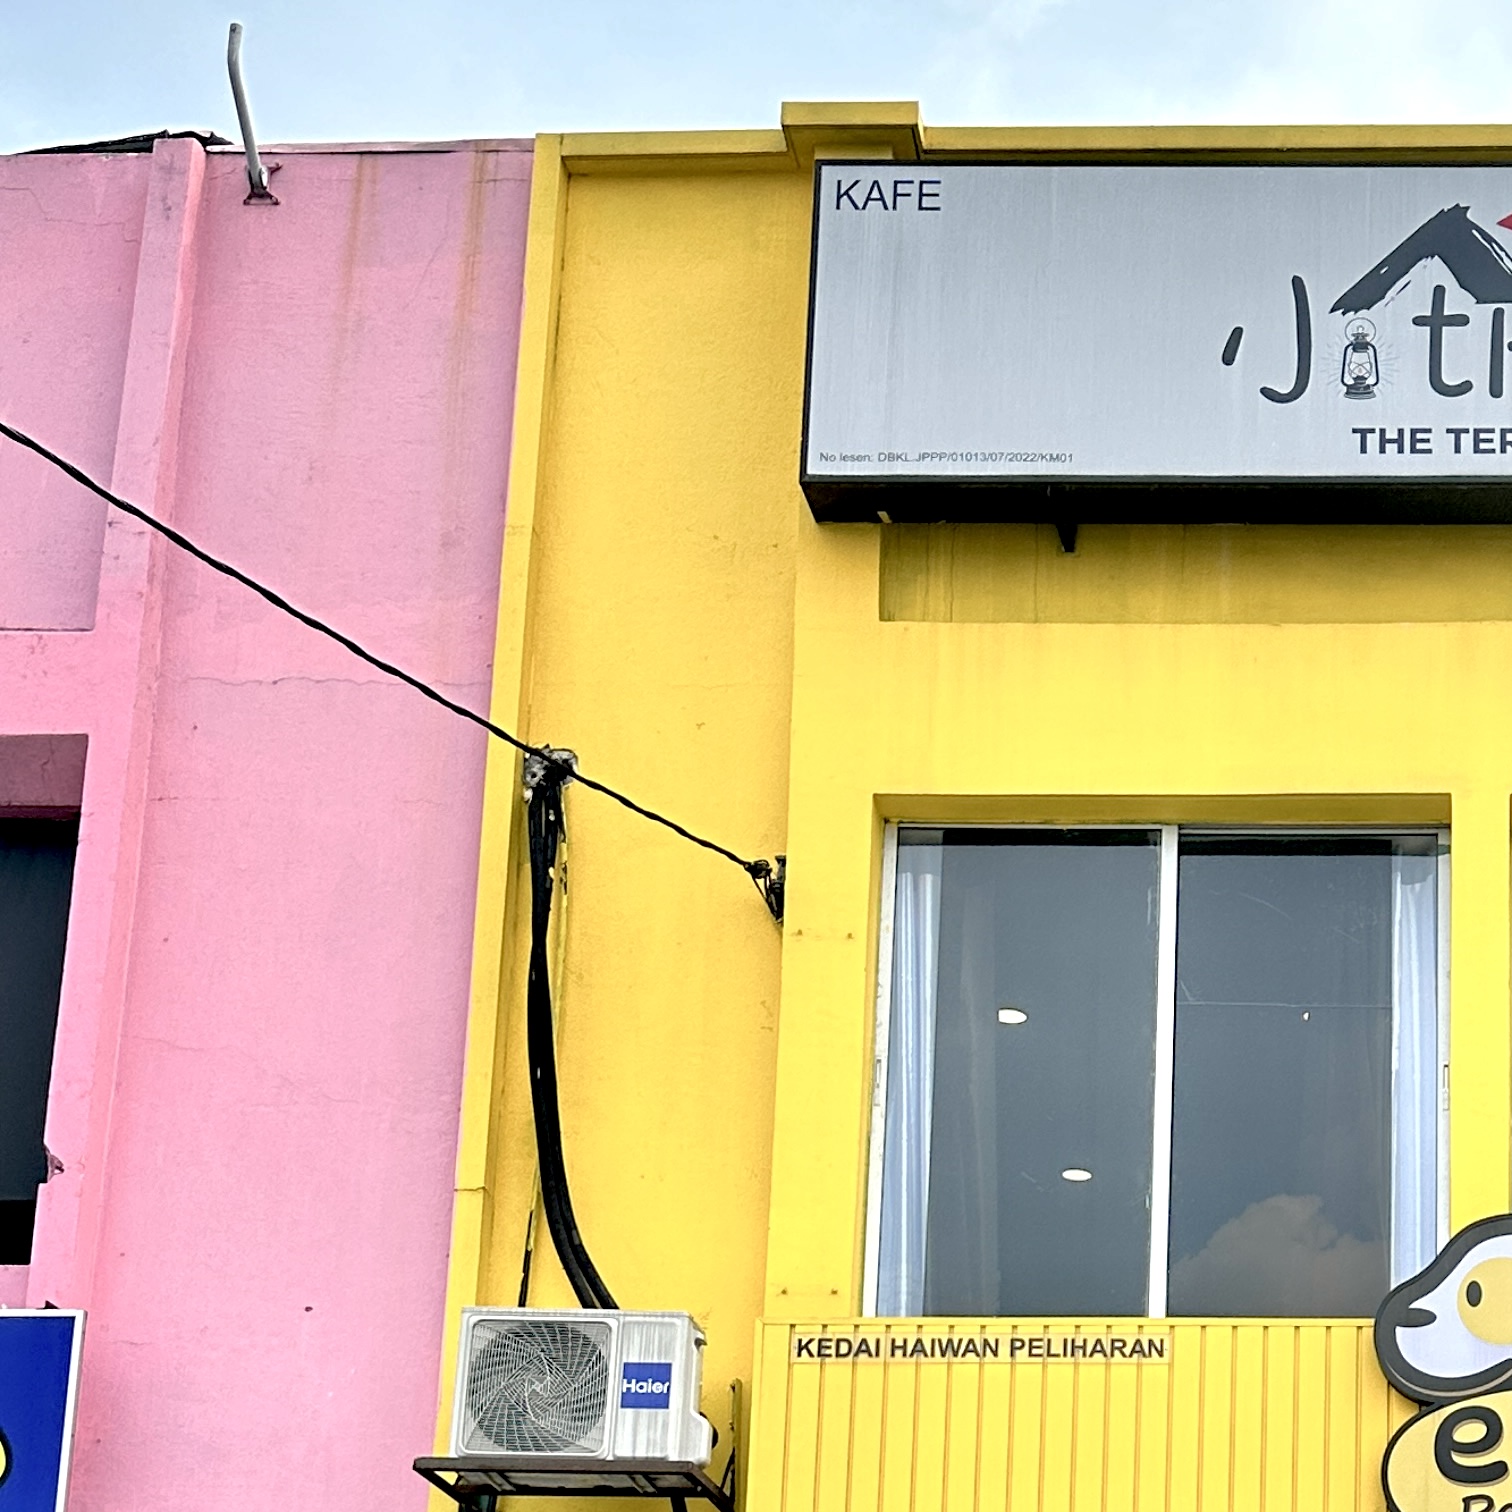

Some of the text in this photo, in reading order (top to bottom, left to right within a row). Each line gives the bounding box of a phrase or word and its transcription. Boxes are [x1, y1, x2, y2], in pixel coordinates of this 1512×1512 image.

[836, 179, 942, 211] KAFE
[1351, 427, 1433, 455] THE
[819, 452, 836, 463] No
[796, 1337, 1165, 1359] KEDAI HAIWAN PELIHARAN
[622, 1377, 670, 1394] Haier
